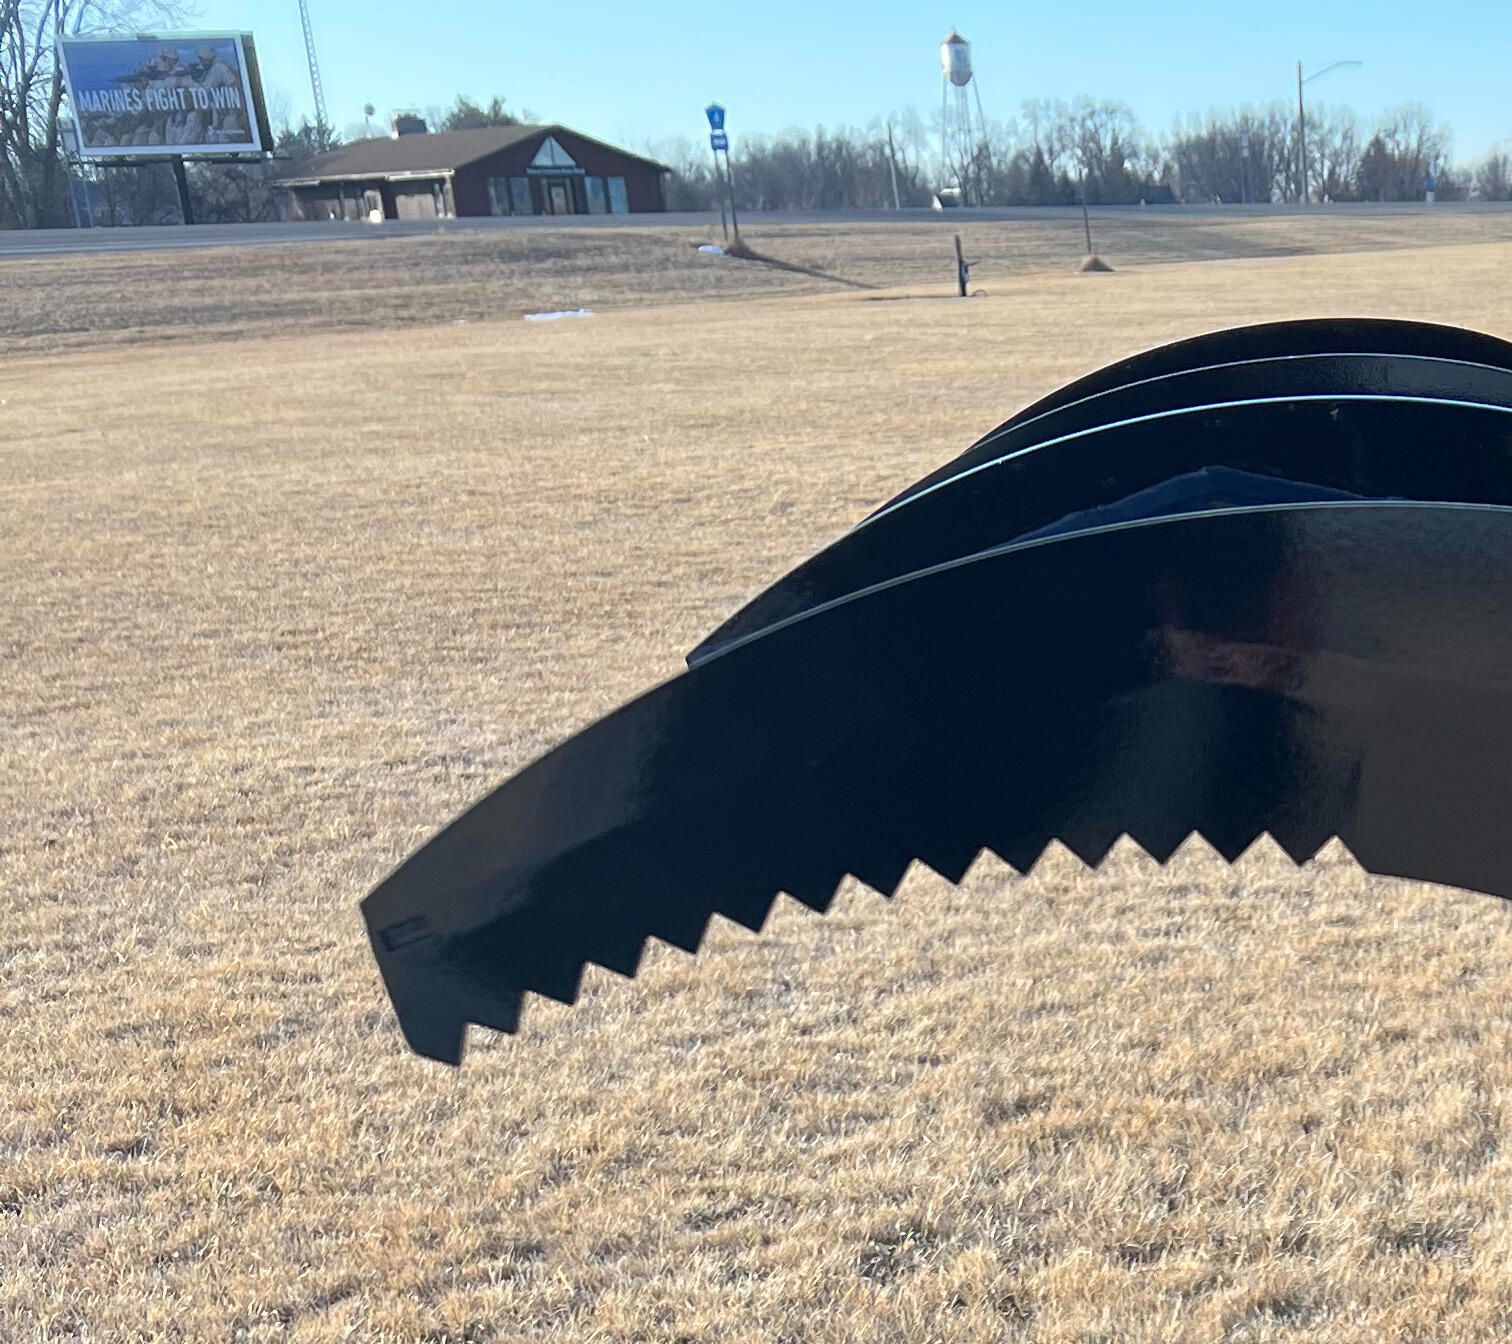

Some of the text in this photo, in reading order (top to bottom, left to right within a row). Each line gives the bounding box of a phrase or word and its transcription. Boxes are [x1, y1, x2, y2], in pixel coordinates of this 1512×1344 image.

[78, 86, 241, 112] MARINES FIGHT TO WIN
